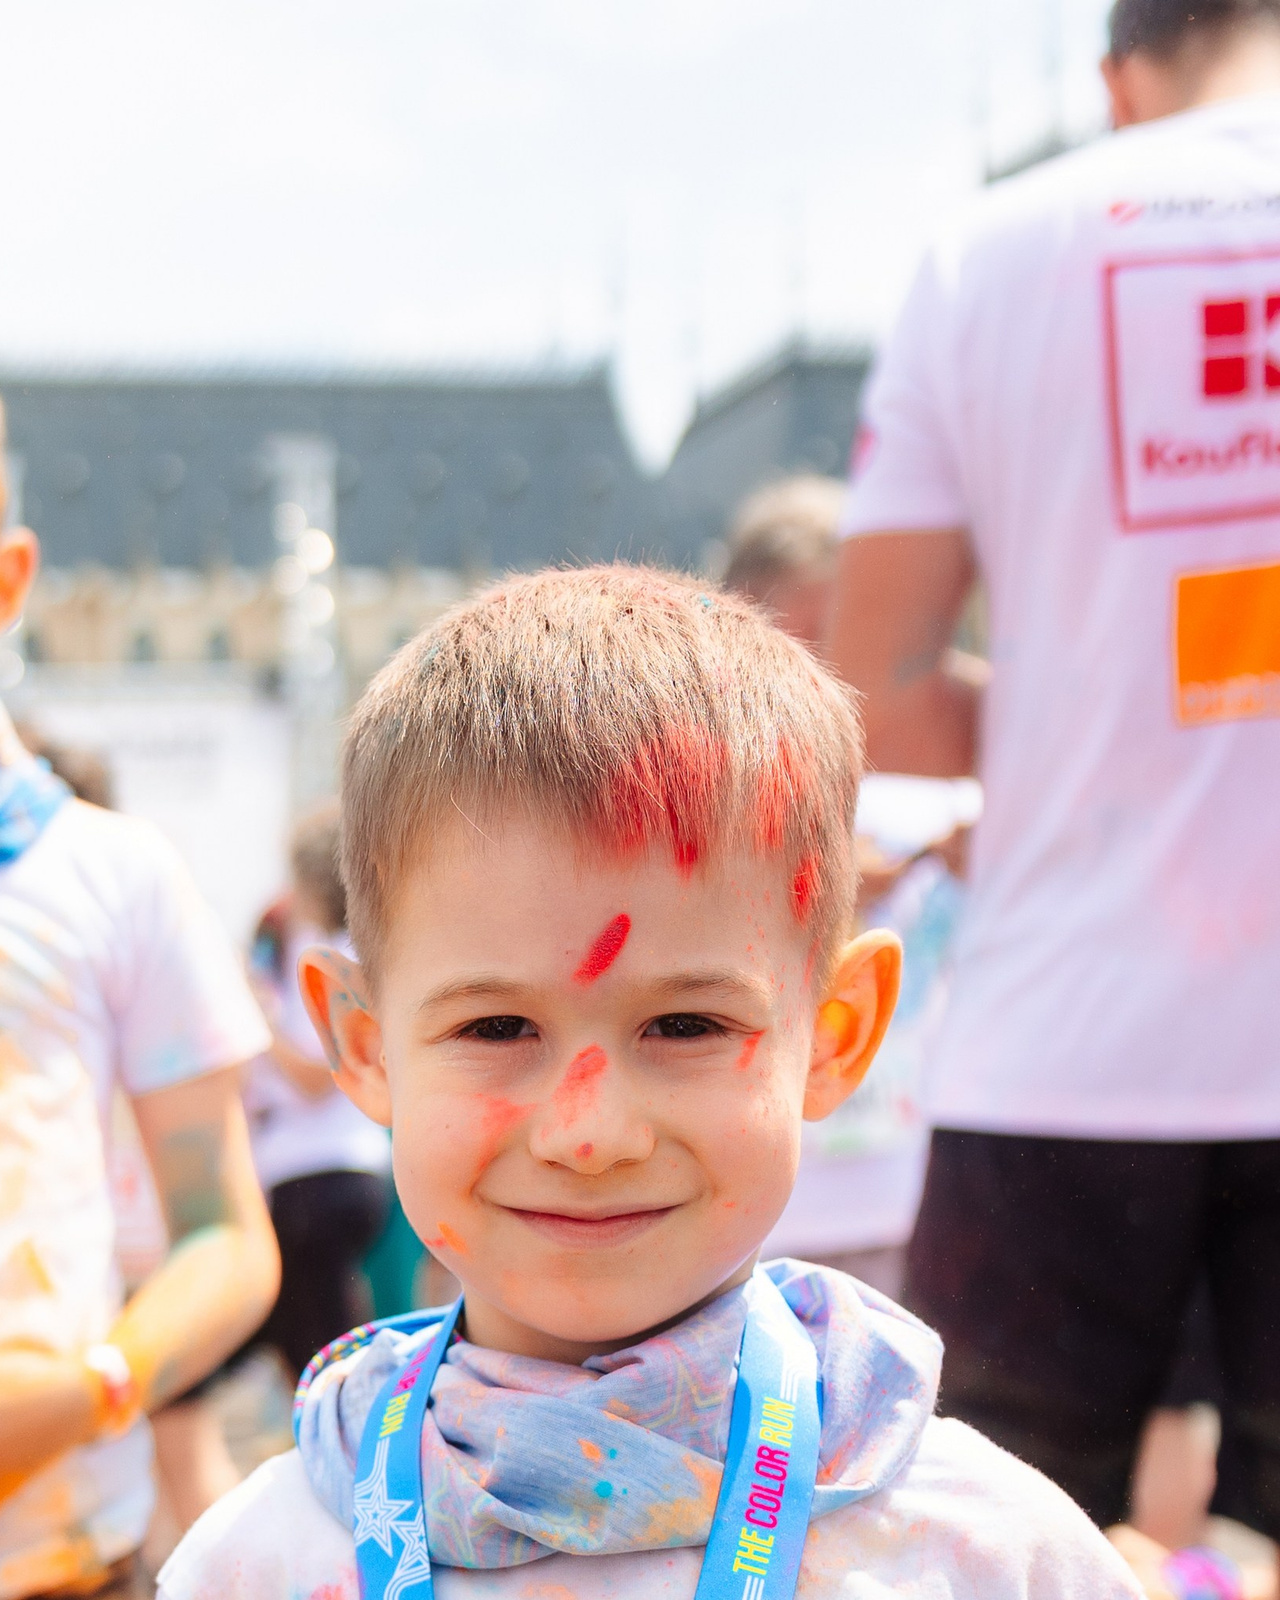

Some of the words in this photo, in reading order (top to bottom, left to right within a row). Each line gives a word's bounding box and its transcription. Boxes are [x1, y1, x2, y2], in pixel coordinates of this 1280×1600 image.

[379, 1391, 411, 1438] RUN
[759, 1396, 796, 1448] RUN
[744, 1444, 790, 1529] COLOR
[732, 1526, 775, 1576] THE
